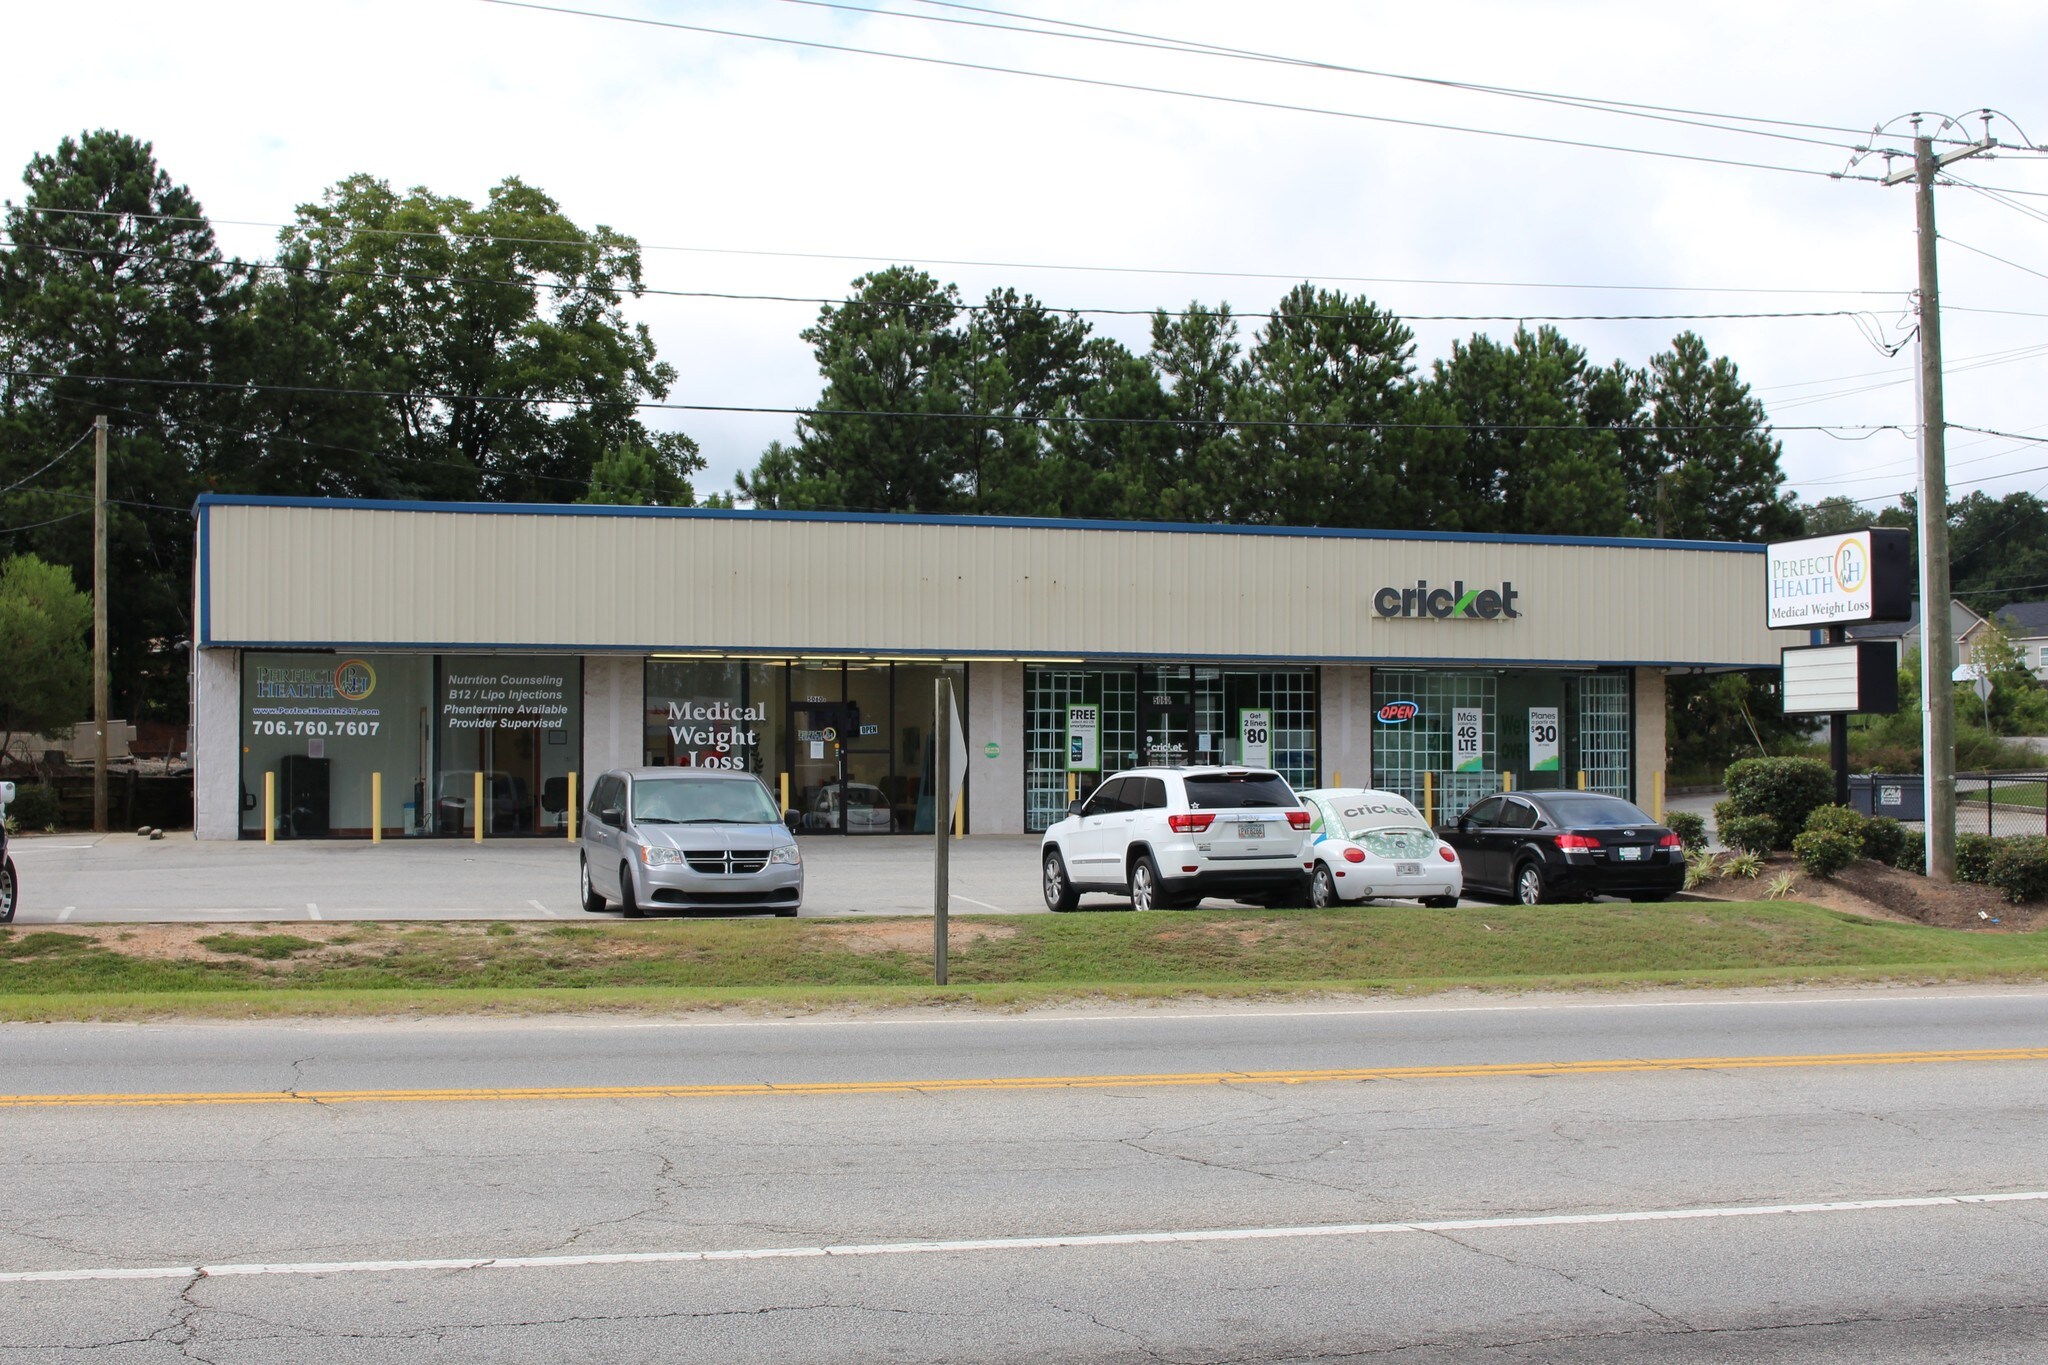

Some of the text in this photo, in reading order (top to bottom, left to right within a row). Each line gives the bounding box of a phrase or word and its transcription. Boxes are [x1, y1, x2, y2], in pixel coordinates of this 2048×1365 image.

[1773, 555, 1834, 579] PERFECT
[1773, 576, 1834, 599] HEALTH
[1373, 579, 1518, 619] cricket
[1772, 600, 1870, 619] Medical Weight Loss
[256, 666, 336, 684] PERFECT
[448, 675, 564, 687] Nutrition Counseling
[256, 680, 335, 699] HEALTH
[449, 689, 471, 700] B12
[480, 690, 506, 702] Lipo
[508, 689, 563, 702] Injections
[252, 707, 380, 716] www.PerfectHealth247.com
[443, 704, 568, 714] Phentermine Available
[667, 701, 767, 721] Medical
[1070, 709, 1096, 720] FREE
[1381, 706, 1415, 719] OPEN
[1531, 711, 1556, 720] Planes
[1244, 719, 1267, 727] 2 lines
[1457, 712, 1477, 721] Más
[252, 720, 380, 736] 706.760.7607
[449, 718, 563, 730] Provider Supervised
[861, 726, 878, 734] OPEN
[669, 726, 757, 753] Weight
[1243, 728, 1268, 744] $80
[1457, 726, 1477, 739] 4G
[1531, 725, 1557, 743] $30
[1458, 739, 1477, 751] LTE
[688, 750, 745, 770] Loss
[1343, 804, 1417, 819] cricket
